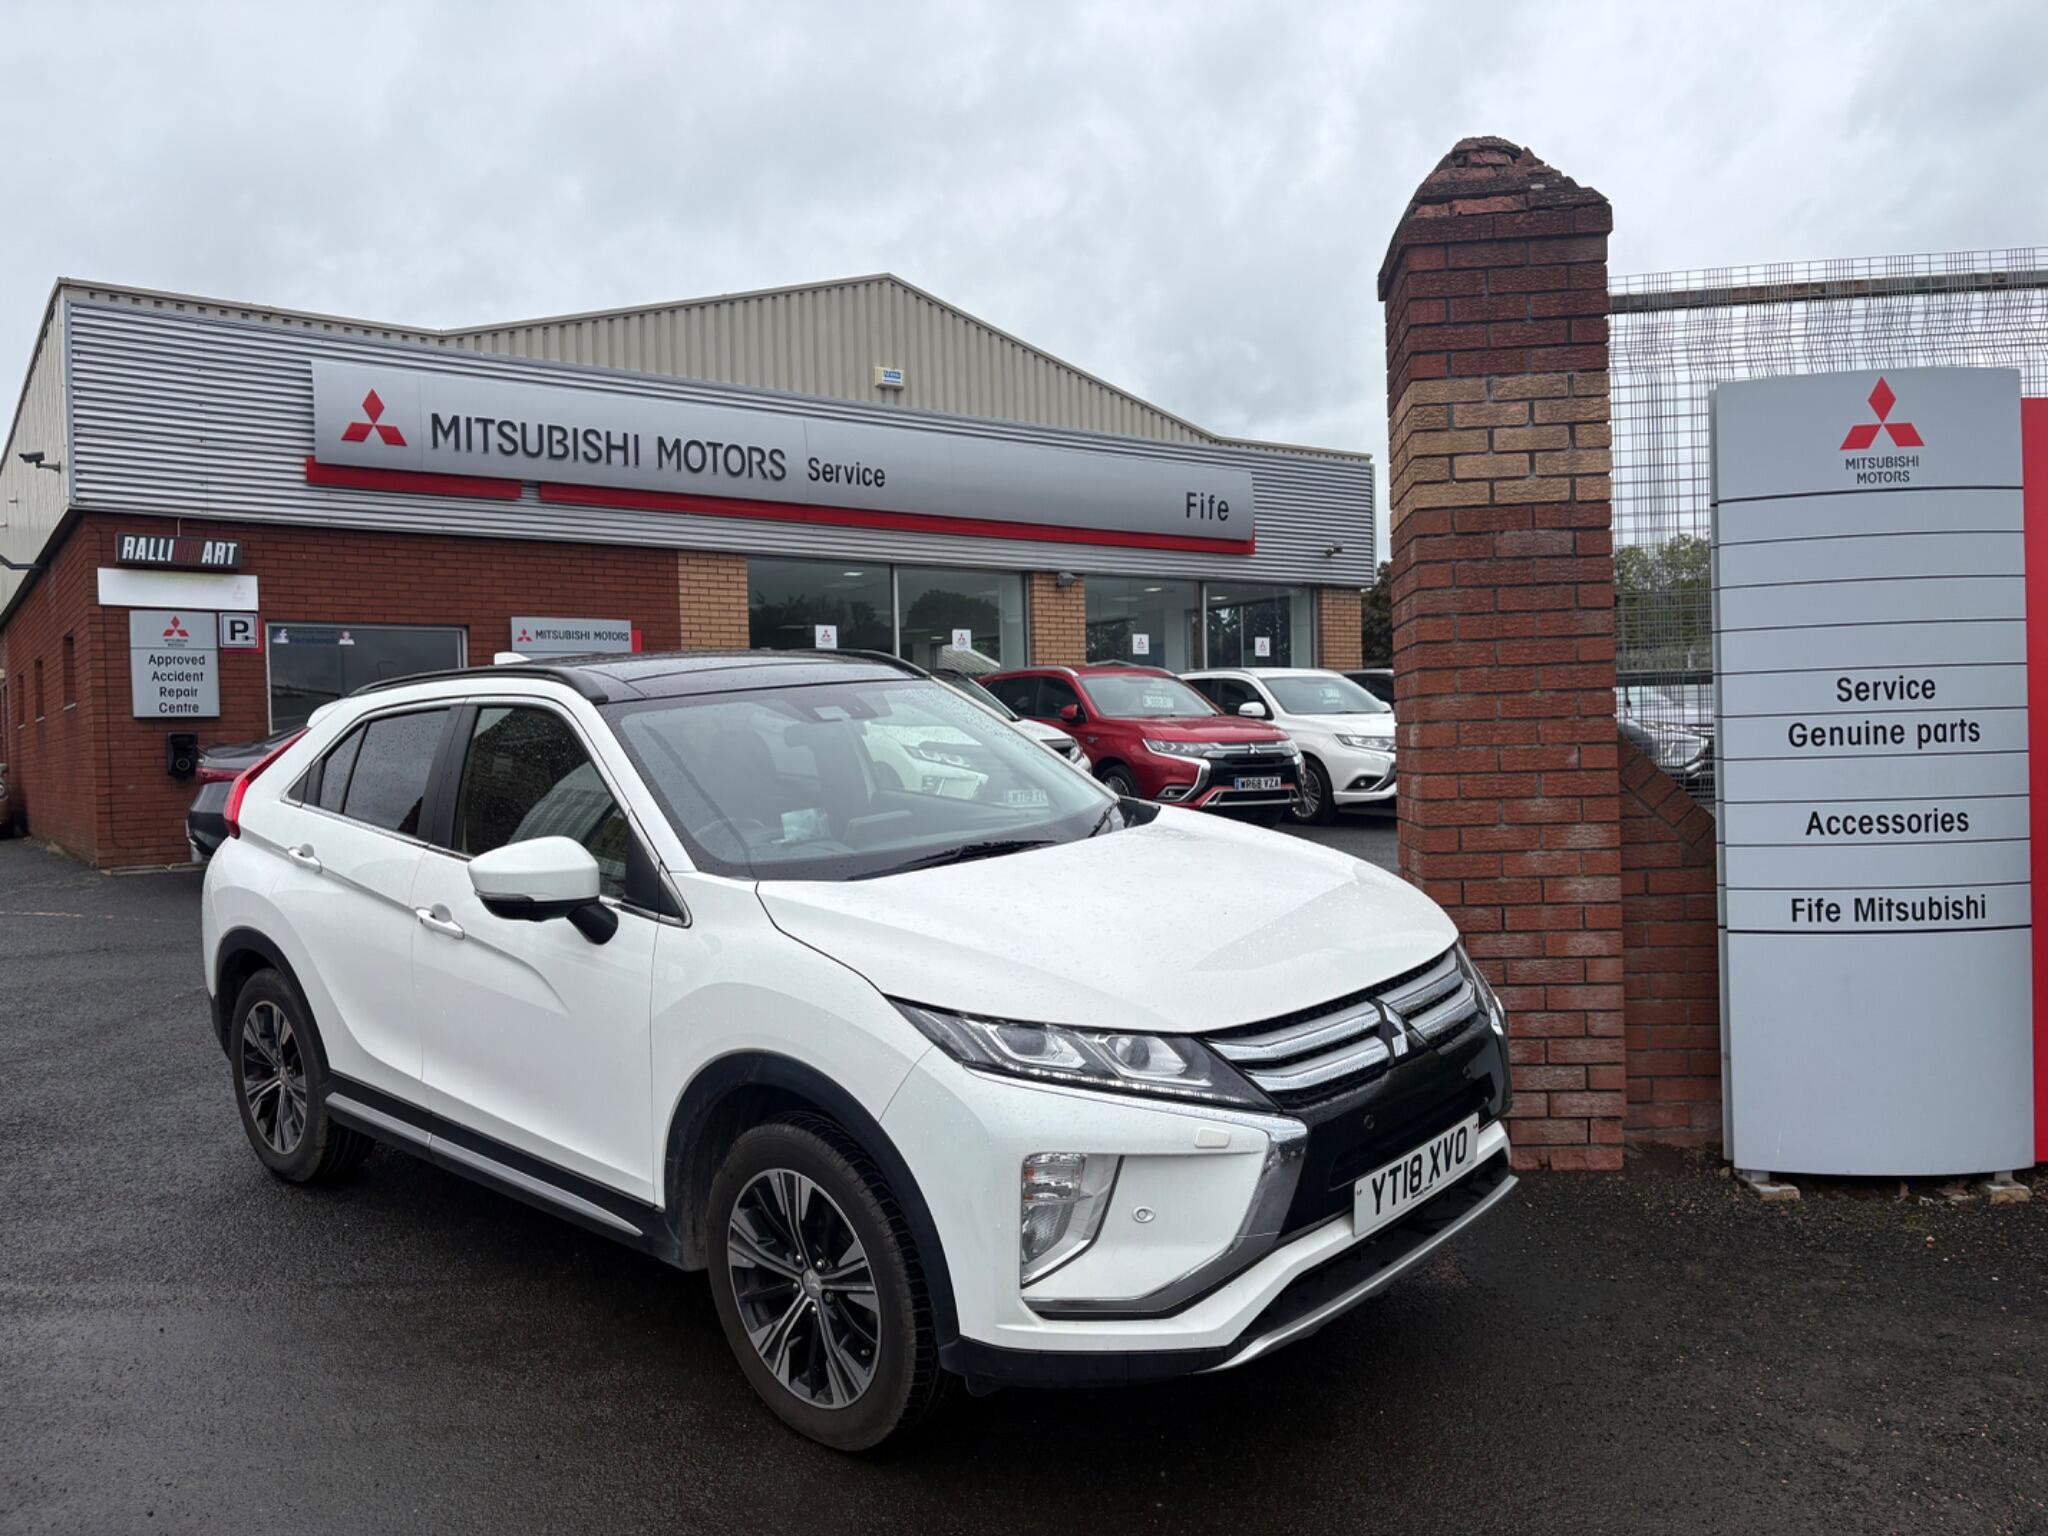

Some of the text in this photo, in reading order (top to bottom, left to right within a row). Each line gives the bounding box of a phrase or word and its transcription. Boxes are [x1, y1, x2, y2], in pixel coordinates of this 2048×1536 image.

[431, 413, 886, 488] MITSUBISHI MOTORS Service
[1845, 455, 1920, 470] MITSUBISHI
[1856, 470, 1911, 485] MOTORS
[1186, 491, 1229, 521] Fife
[230, 620, 249, 640] P
[535, 630, 629, 642] MITSUBISHI MOTORS
[148, 654, 206, 667] Approved
[152, 671, 204, 682] Accident
[159, 687, 199, 699] Repair
[1836, 675, 1936, 703] Service
[158, 702, 199, 714] Centre
[1788, 718, 1980, 750] Genuine parts
[1805, 808, 1969, 836] Accessories
[1791, 894, 1986, 923] Fife Mitsubishi
[1371, 1126, 1468, 1216] YT18 XVO
